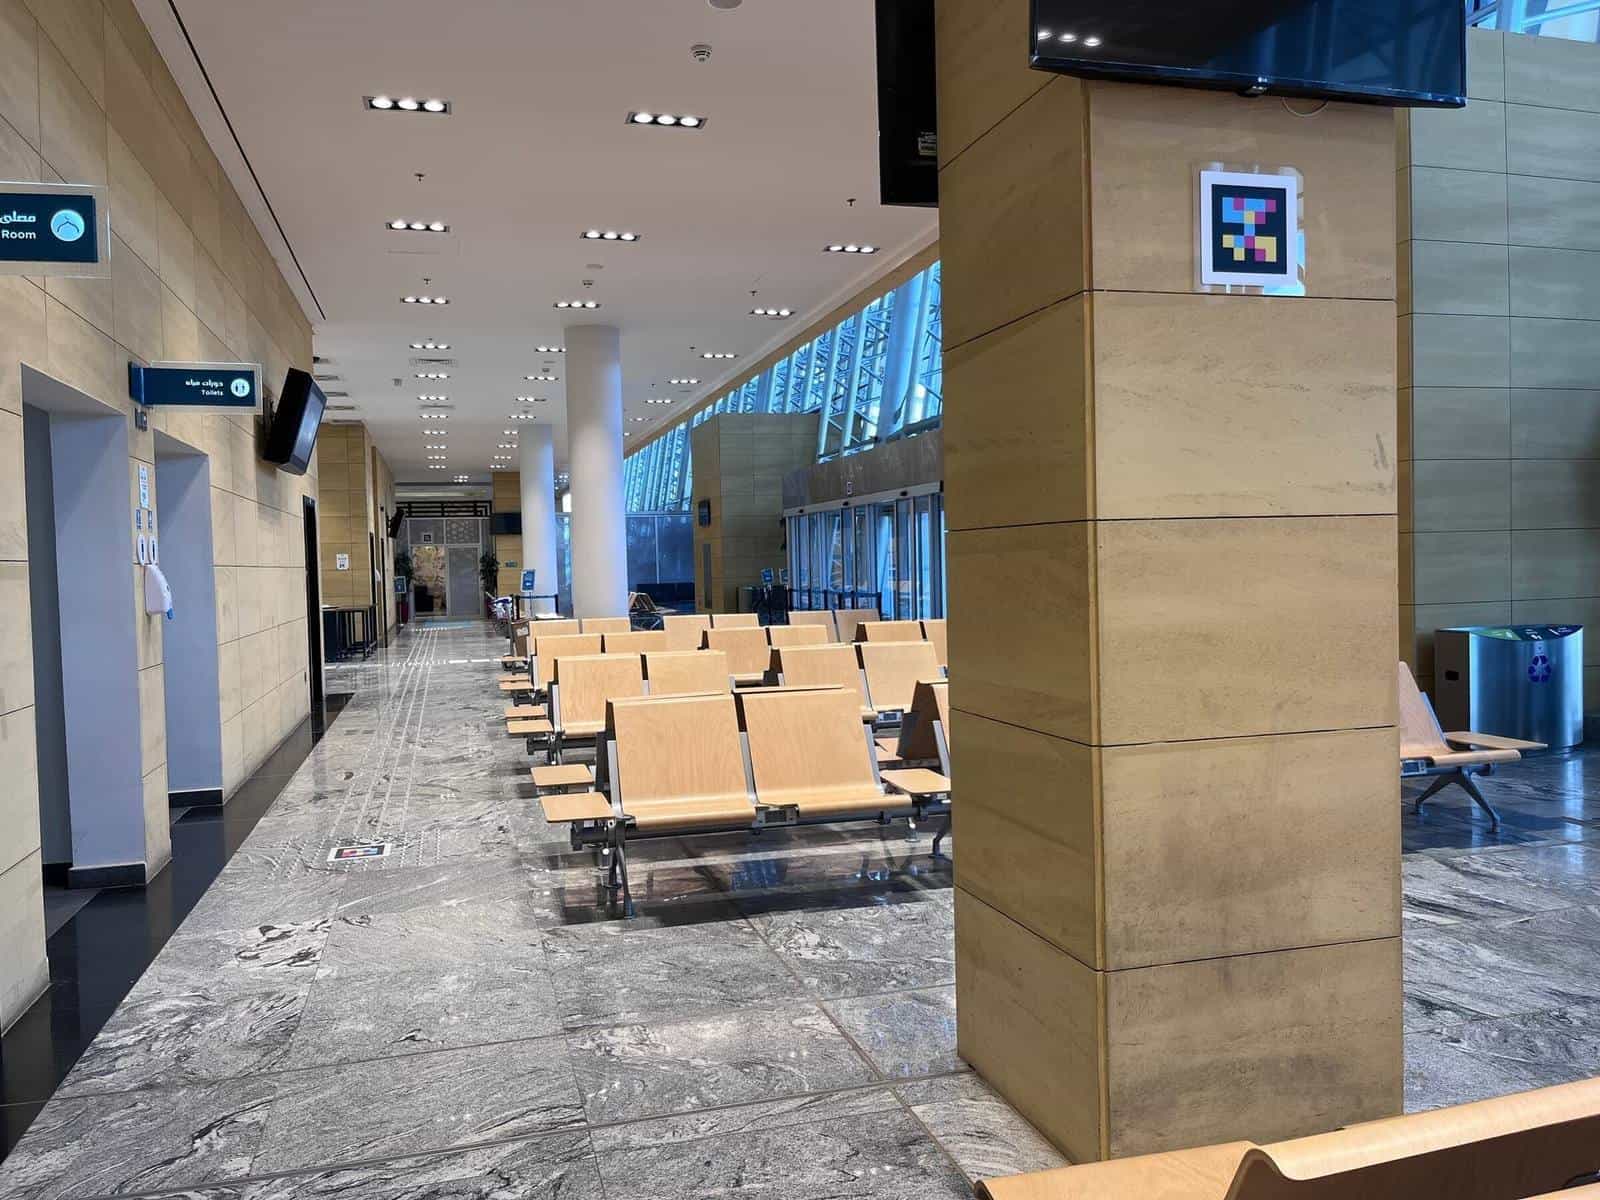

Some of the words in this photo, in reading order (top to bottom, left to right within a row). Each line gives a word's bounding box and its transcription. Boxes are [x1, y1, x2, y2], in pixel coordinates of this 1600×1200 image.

[0, 210, 37, 224] مصلى
[1, 229, 37, 240] Room
[201, 389, 224, 397] Toilets
